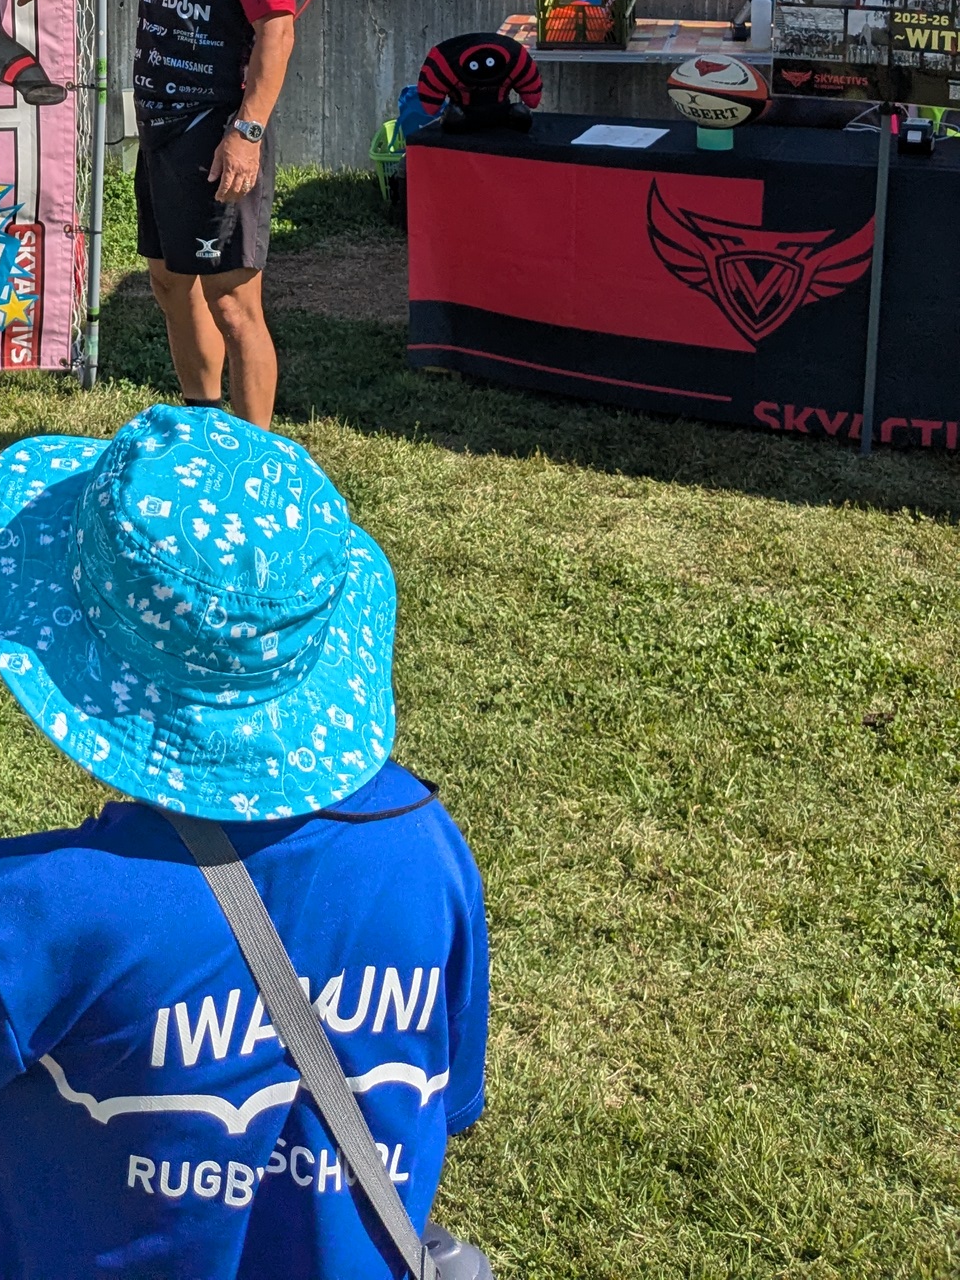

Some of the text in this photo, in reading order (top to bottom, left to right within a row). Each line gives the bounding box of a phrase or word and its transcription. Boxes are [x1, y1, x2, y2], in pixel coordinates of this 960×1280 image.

[894, 12, 949, 26] 2025-26
[173, 28, 194, 37] SPORTS
[894, 27, 960, 52] ~WIT
[177, 35, 224, 47] TRAVEL SERVICE
[162, 56, 213, 74] RENAISSANCE
[814, 73, 869, 86] SKYACTIVS
[12, 230, 36, 363] SKYAIVS
[127, 1137, 409, 1207] RUGB SCHL
